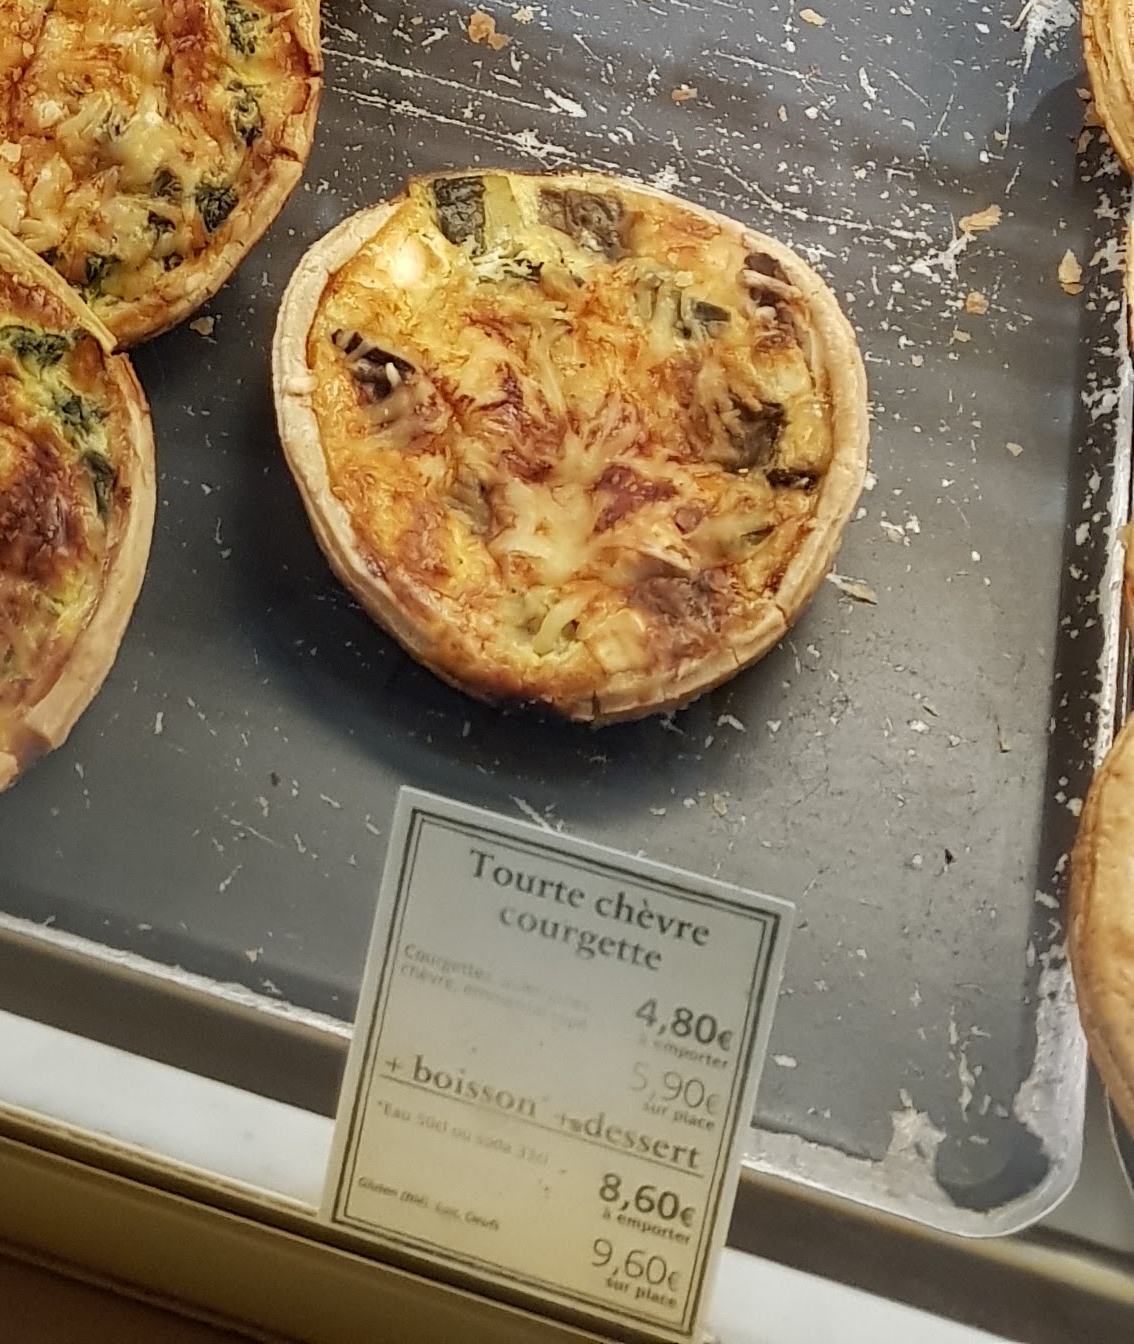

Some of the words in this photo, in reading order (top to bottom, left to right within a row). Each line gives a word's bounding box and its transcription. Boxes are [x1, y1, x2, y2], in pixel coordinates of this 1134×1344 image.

[469, 847, 586, 909] Tourte
[594, 890, 711, 947] chèvre
[498, 906, 663, 972] courgette
[634, 997, 734, 1052] 4,80€
[584, 1111, 701, 1169] dessert
[599, 1172, 697, 1229] 8,60€
[616, 1212, 691, 1245] emporter
[590, 1237, 682, 1293] 9,60€
